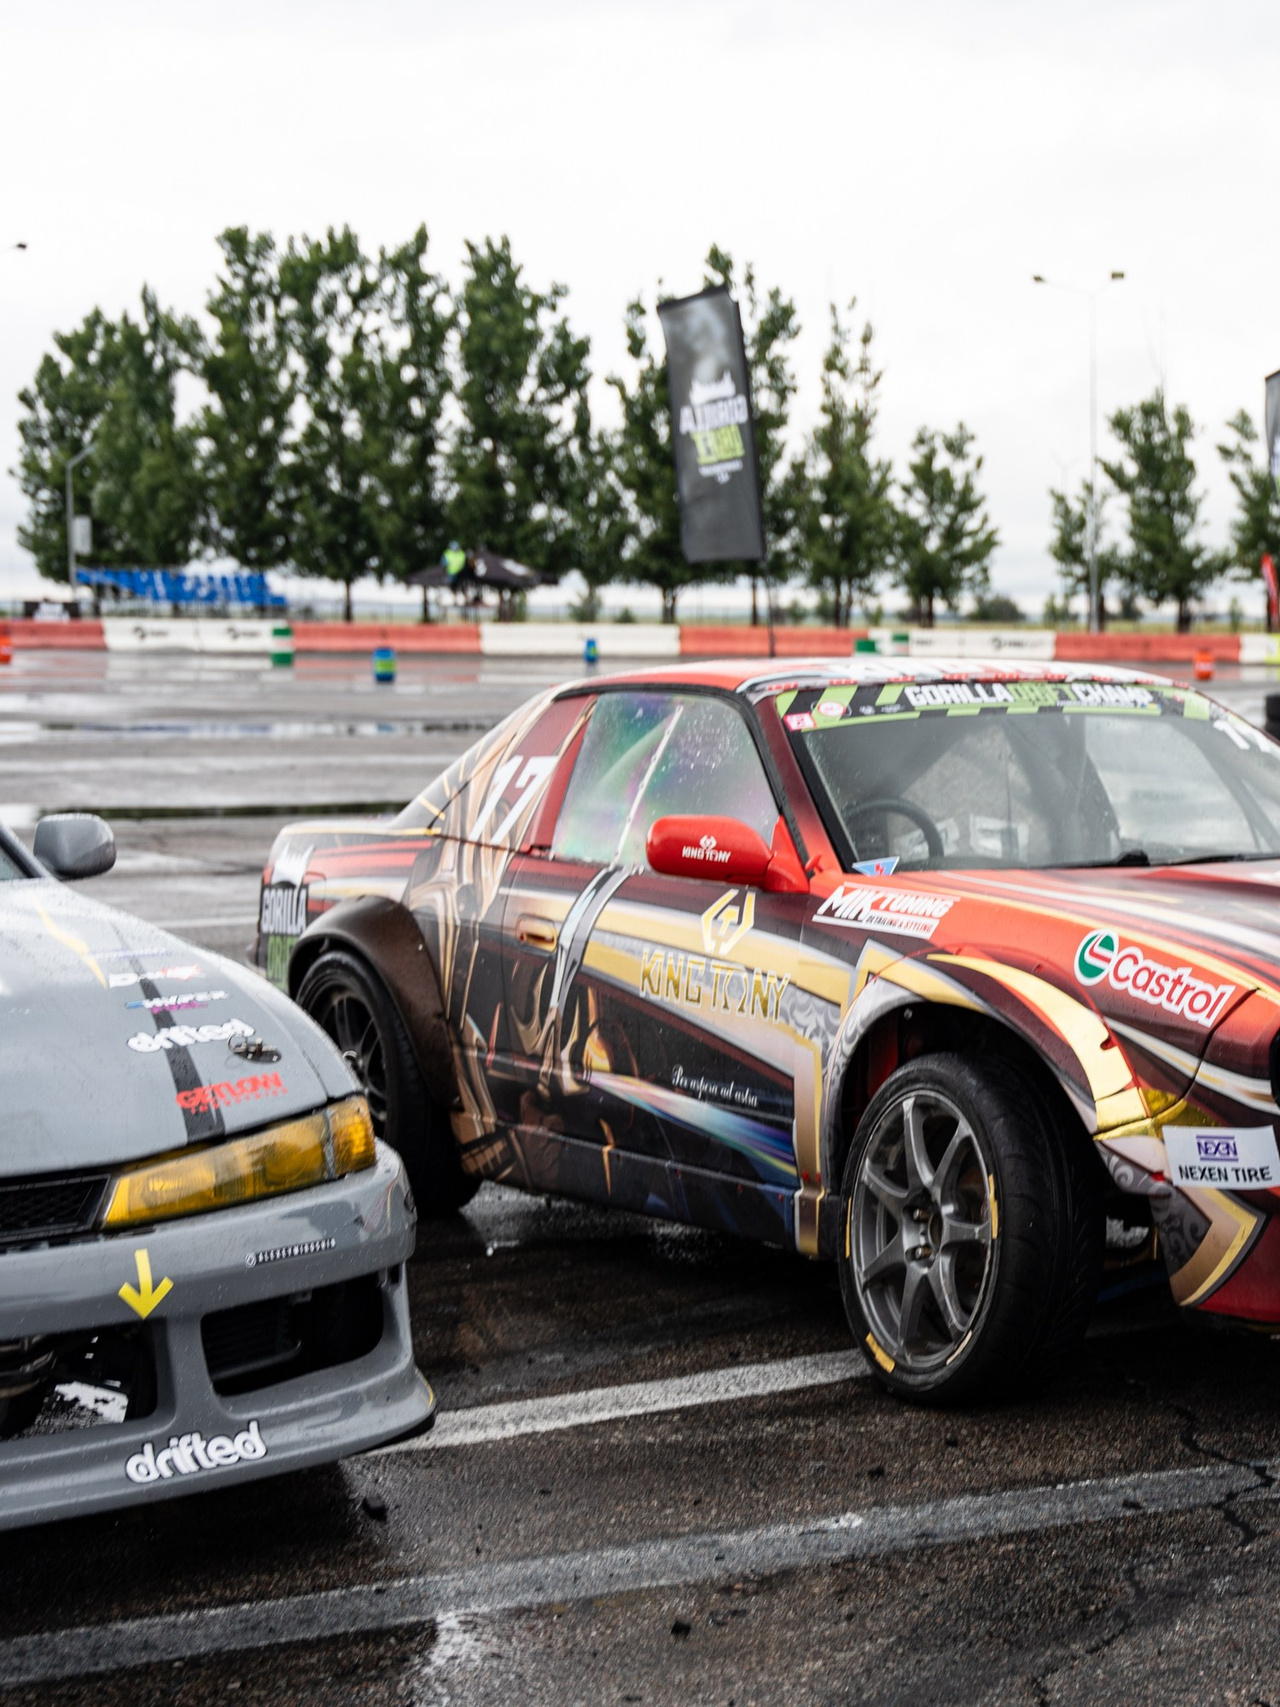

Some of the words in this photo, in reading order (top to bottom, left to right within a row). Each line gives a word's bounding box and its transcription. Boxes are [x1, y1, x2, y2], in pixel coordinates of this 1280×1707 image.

[904, 683, 1015, 707] GORILLA
[468, 755, 559, 847] 17
[261, 886, 308, 935] GORILLA
[877, 891, 955, 918] TUNING
[640, 948, 705, 1008] KING
[709, 962, 791, 1024] TONY
[1111, 950, 1228, 1024] Castrol
[720, 1080, 735, 1100] ad
[1196, 1138, 1238, 1158] NEXEN
[1178, 1164, 1228, 1182] NEXEN
[1231, 1165, 1273, 1183] TIRE
[126, 1420, 268, 1484] drifted
